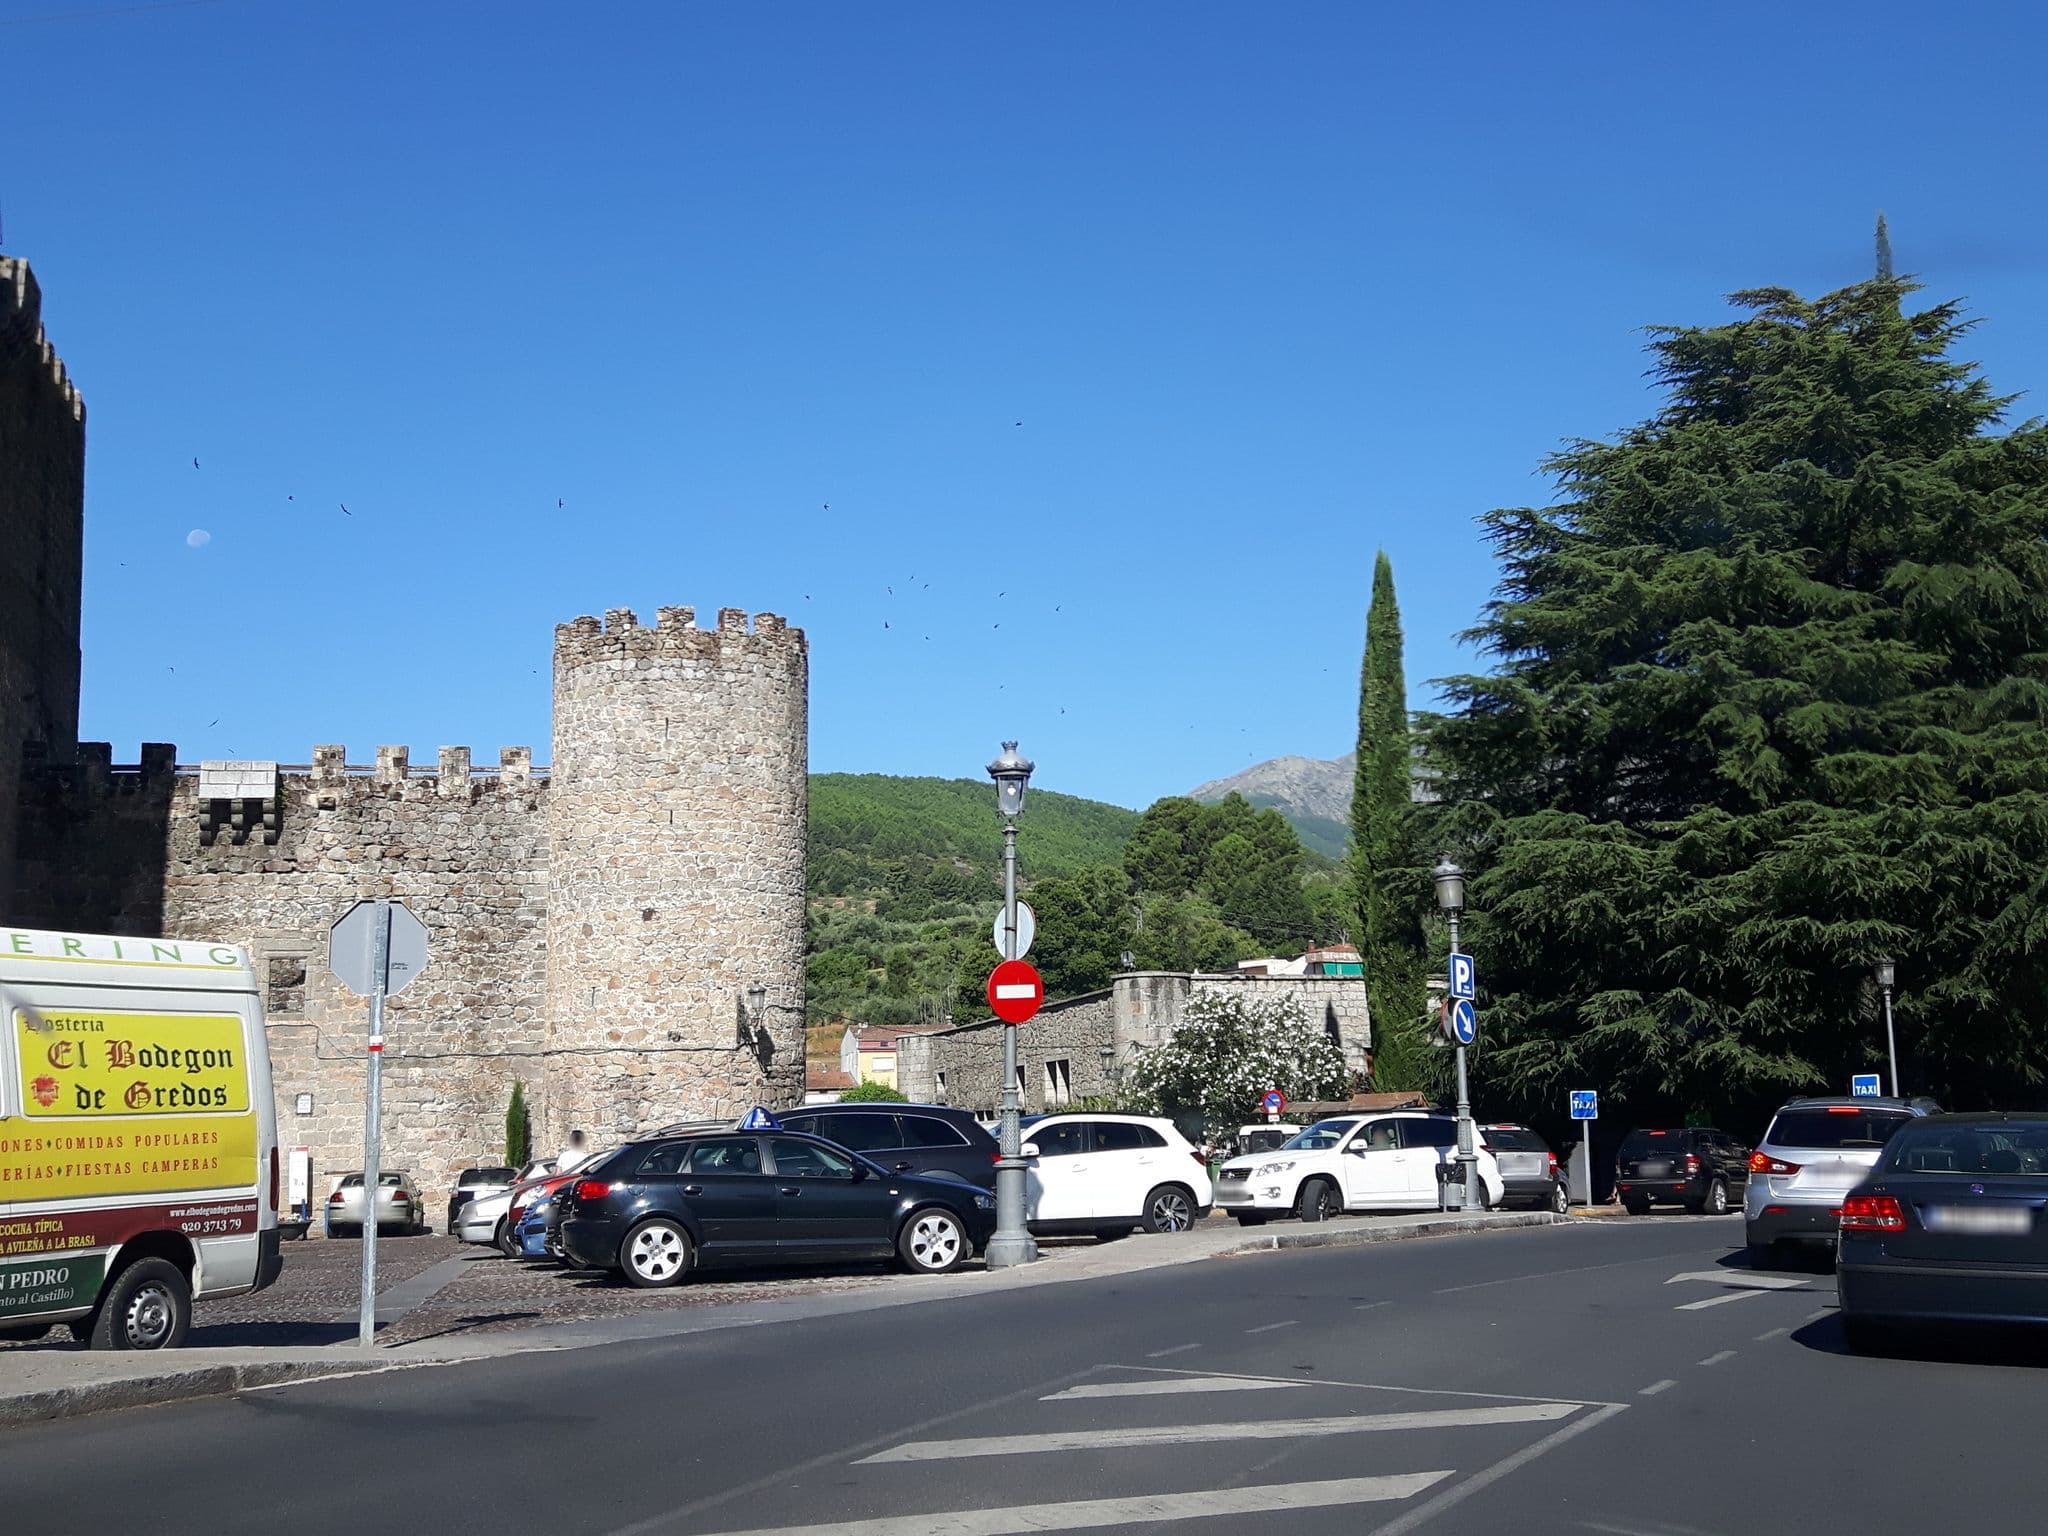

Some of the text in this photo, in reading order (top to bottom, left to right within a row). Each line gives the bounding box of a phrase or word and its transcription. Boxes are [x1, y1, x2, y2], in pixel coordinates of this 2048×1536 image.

[11, 933, 238, 965] ERING
[1455, 959, 1470, 993] P
[23, 1015, 105, 1034] osteria
[47, 1039, 234, 1074] El Bodegon
[75, 1080, 228, 1110] de Gredos
[1855, 1085, 1877, 1095] TAXI
[1, 1132, 219, 1153] ONES COMIDAS POPULARES
[3, 1157, 219, 1181] ERÍAS FIESTAS CAMPERAS
[0, 1218, 64, 1236] COCINA TÍPICA
[181, 1221, 201, 1233] 920
[229, 1218, 242, 1230] 79
[6, 1237, 44, 1254] AVILEÑA
[46, 1238, 53, 1250] A
[54, 1237, 66, 1249] LA
[68, 1235, 96, 1248] BRASA
[9, 1267, 70, 1290] PEDRO
[18, 1293, 29, 1304] al
[30, 1287, 75, 1304] Castillo)
